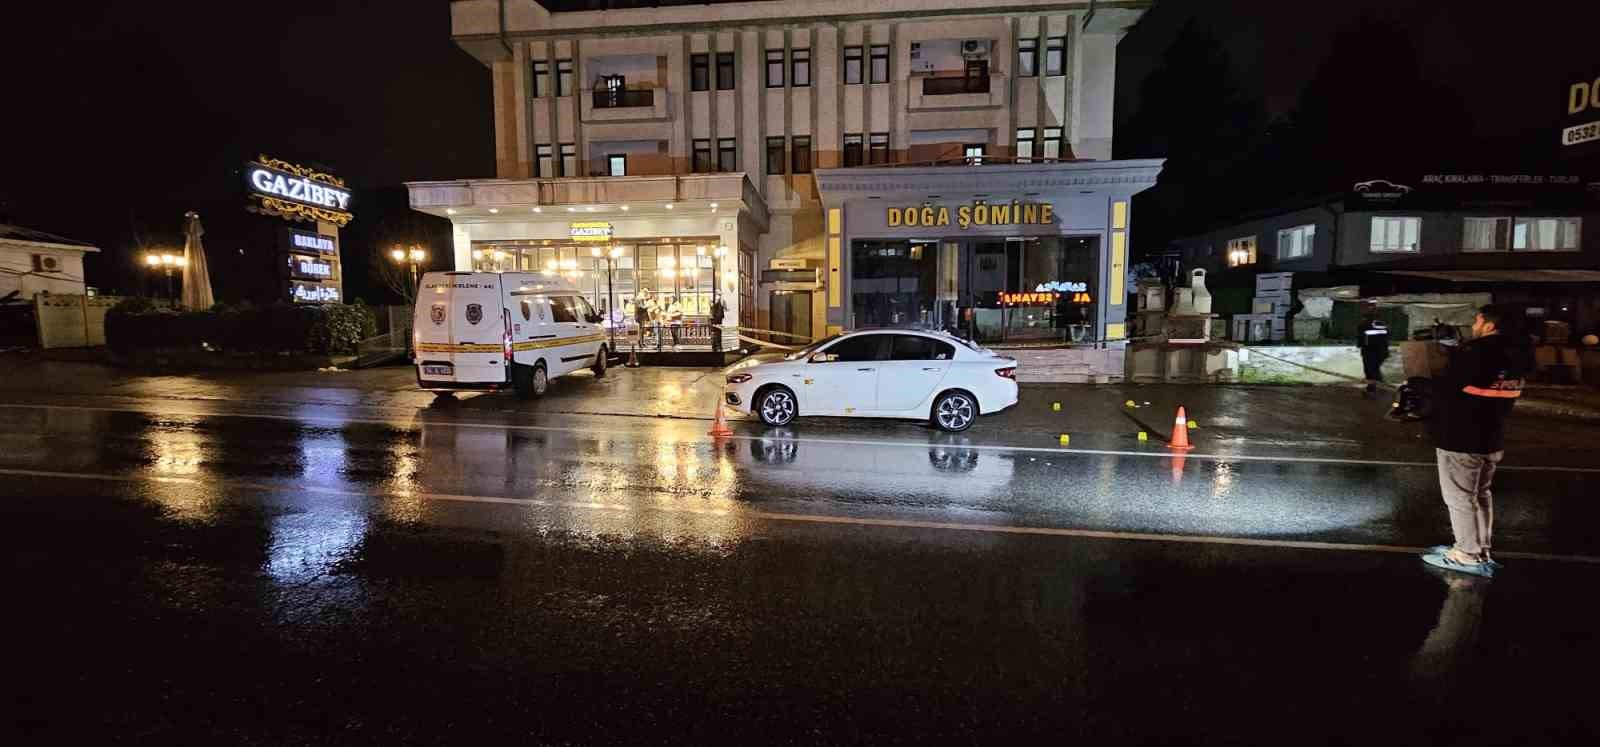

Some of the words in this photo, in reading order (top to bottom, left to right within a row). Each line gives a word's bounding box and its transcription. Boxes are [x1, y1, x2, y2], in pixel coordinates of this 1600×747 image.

[1568, 125, 1596, 142] 0532
[251, 168, 352, 210] GAZİBEY
[887, 201, 950, 228] DOĞA
[958, 200, 1054, 230] ŞÖMİNE
[294, 234, 334, 252] BAKLAVA
